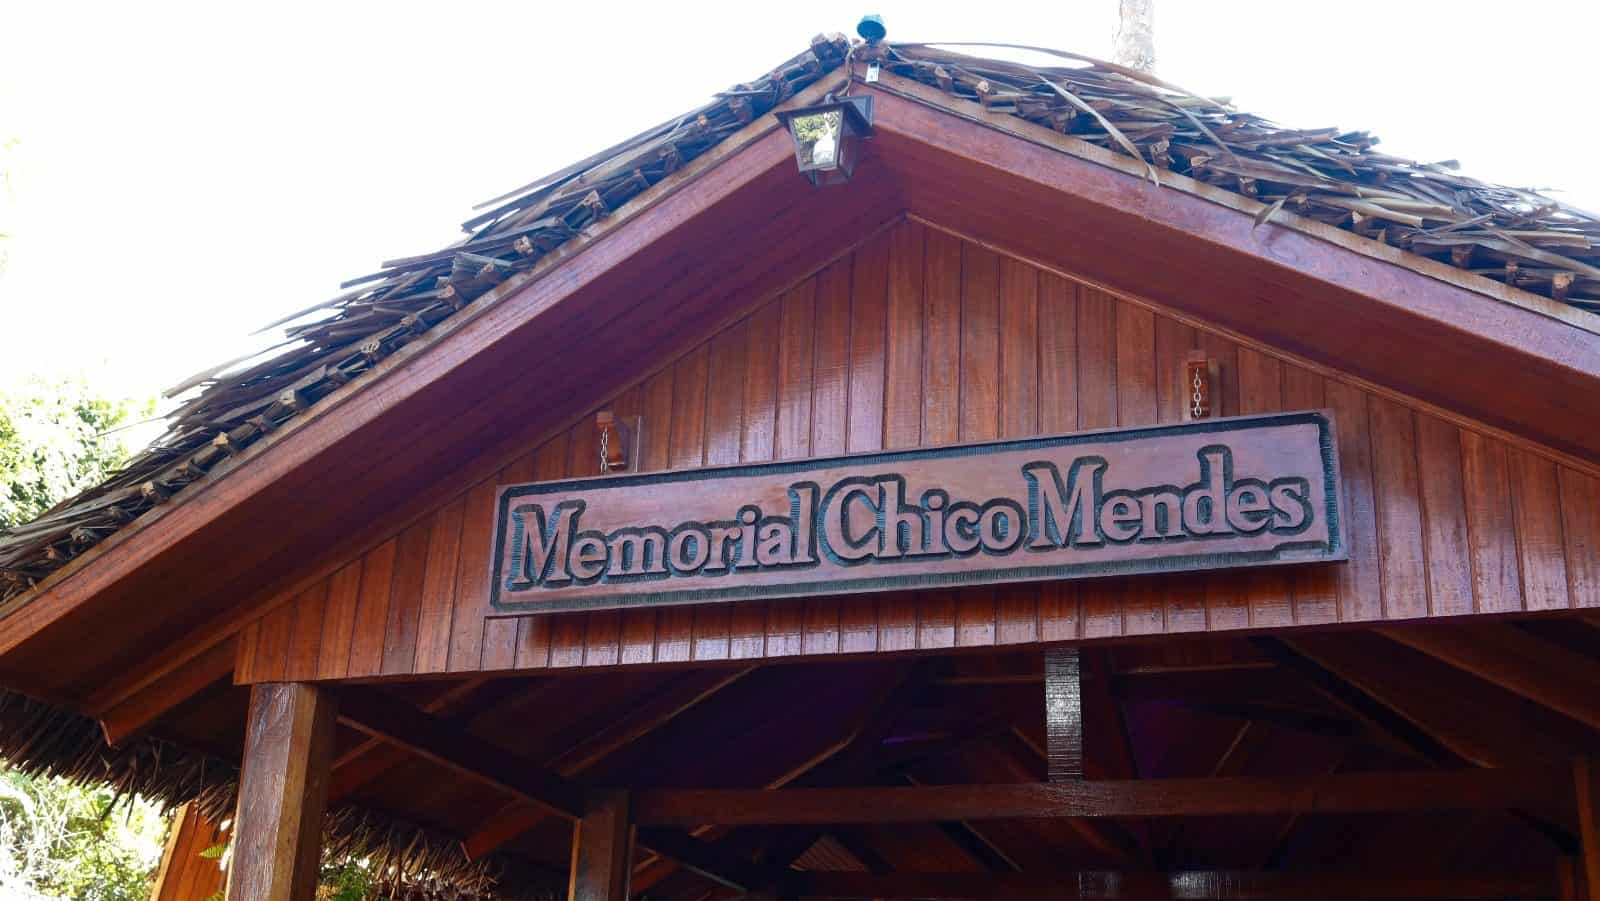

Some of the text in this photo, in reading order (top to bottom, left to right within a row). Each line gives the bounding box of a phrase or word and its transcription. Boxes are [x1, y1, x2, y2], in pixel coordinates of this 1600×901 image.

[510, 450, 1307, 585] Memorial Chico Mendes
